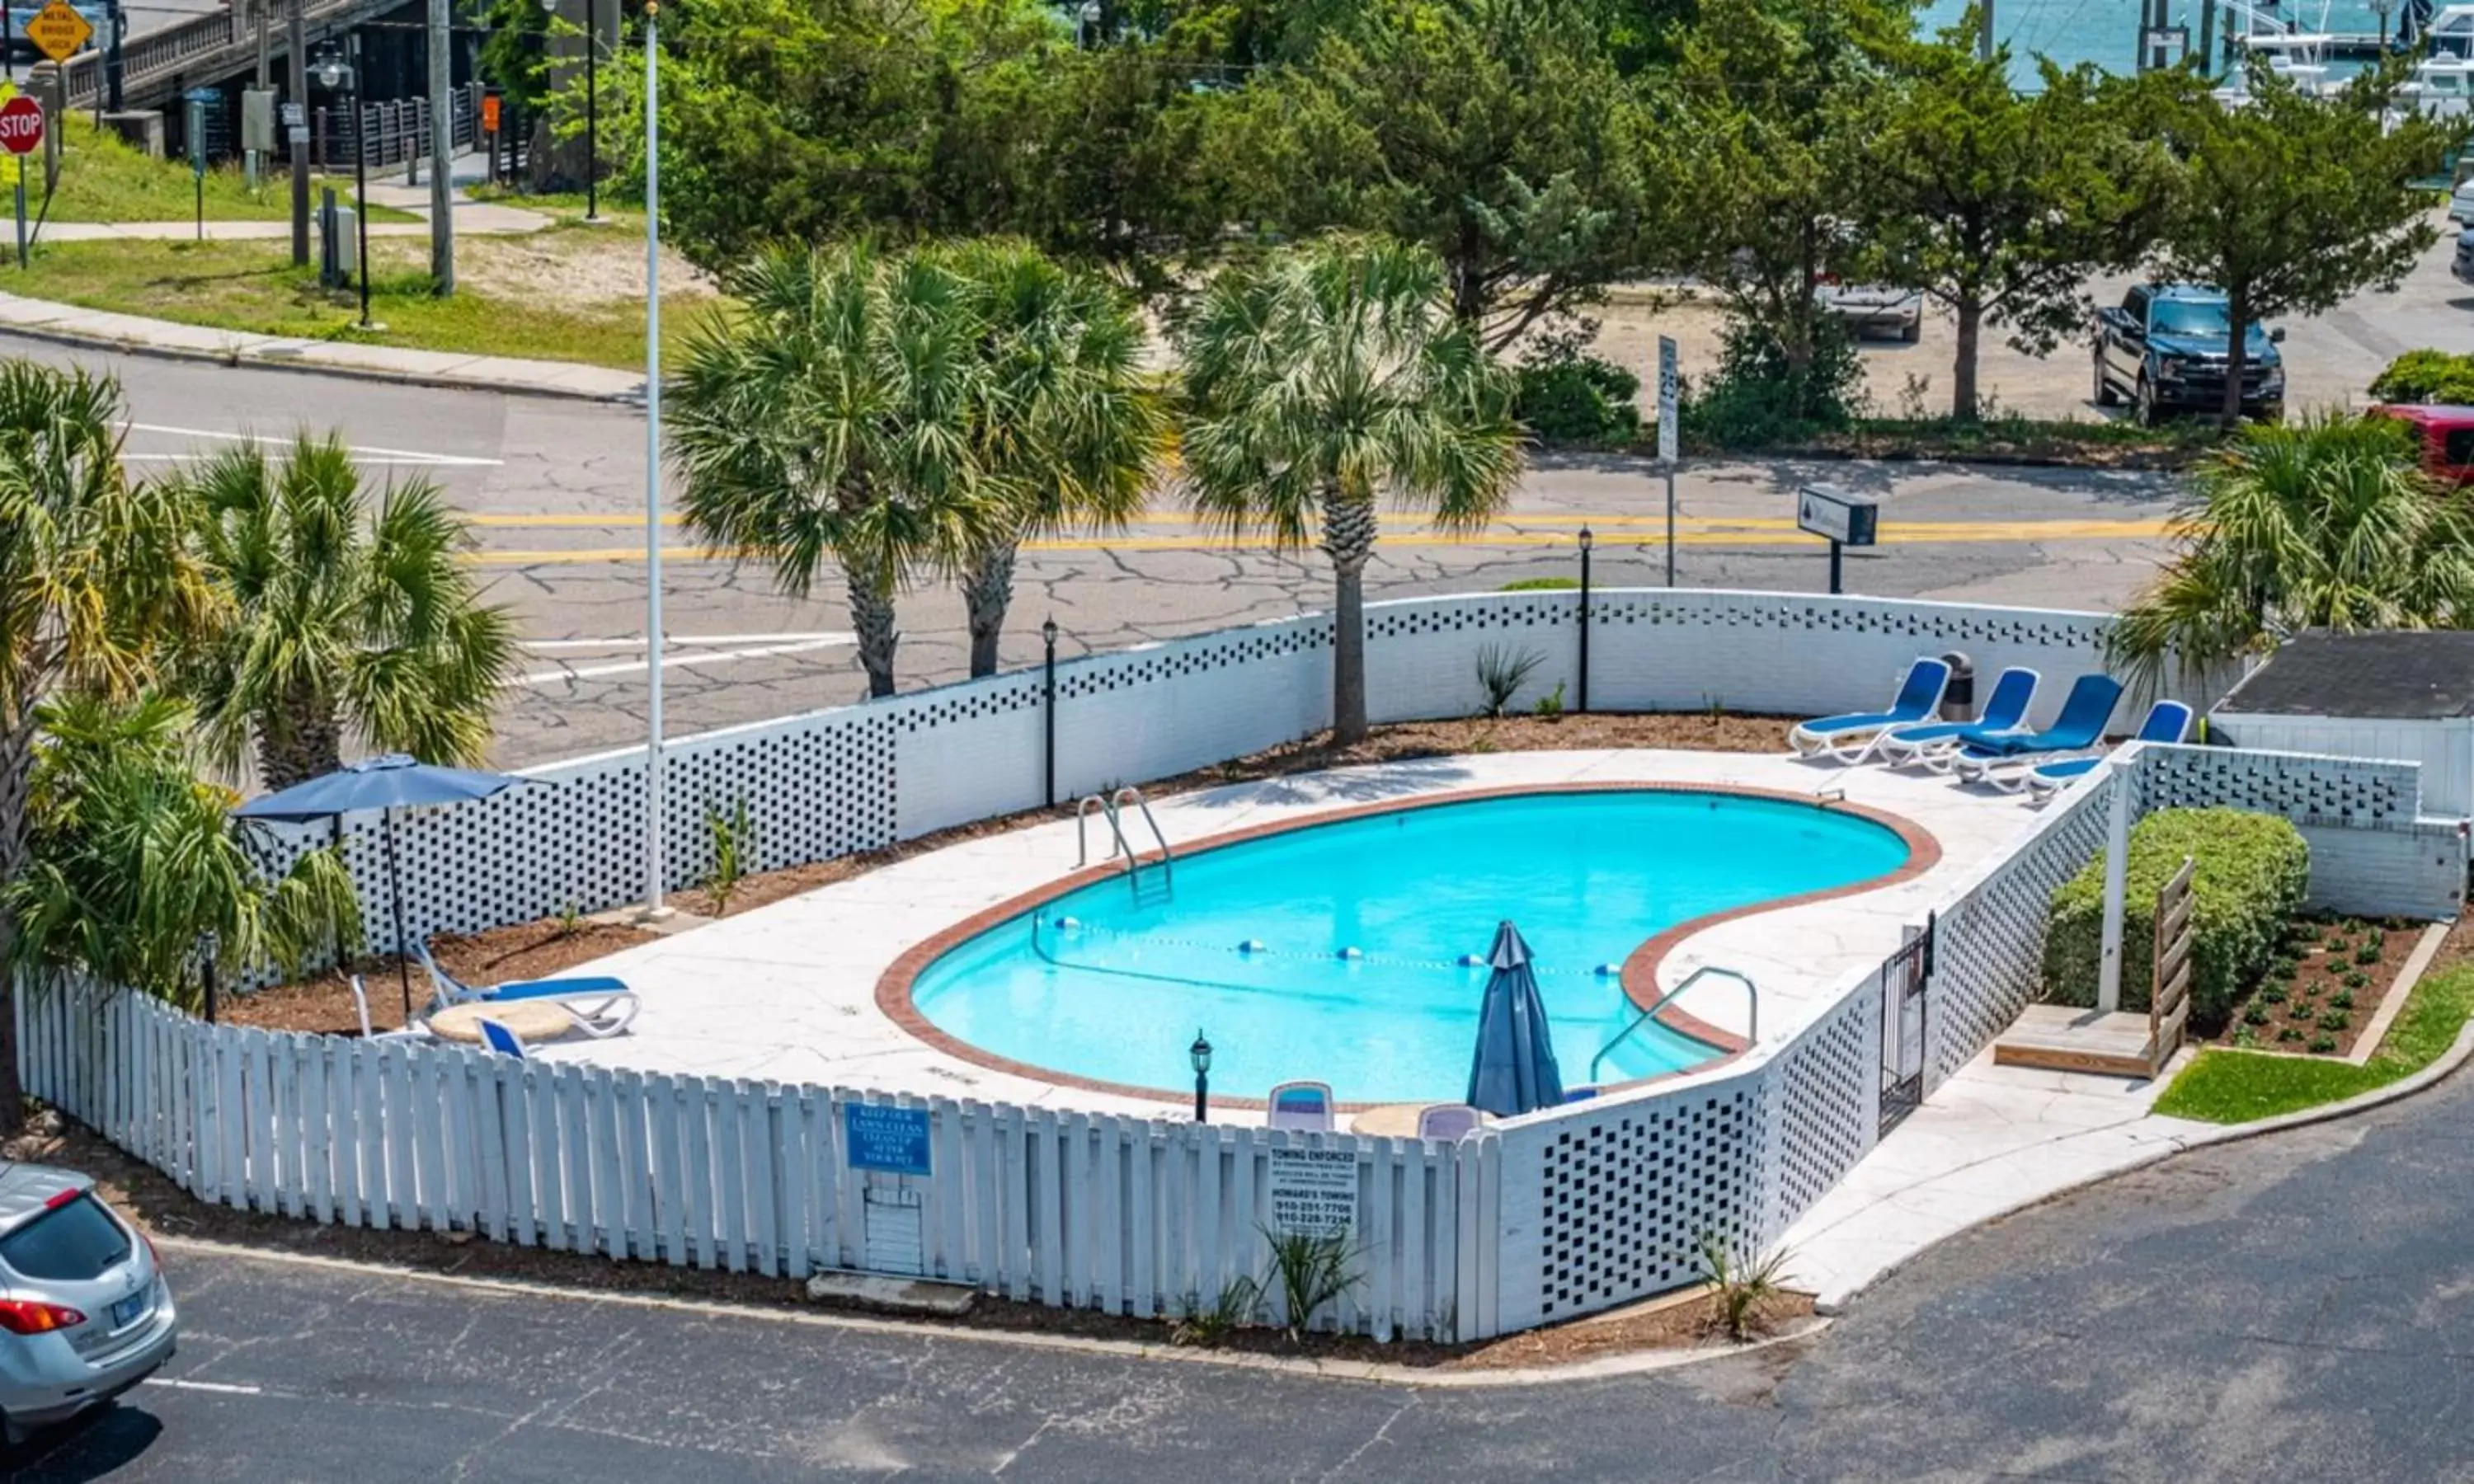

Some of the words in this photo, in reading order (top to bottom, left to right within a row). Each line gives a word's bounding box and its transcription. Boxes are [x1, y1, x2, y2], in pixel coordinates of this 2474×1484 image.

[41, 26, 75, 35] BRIDGE
[0, 113, 40, 138] STOP
[860, 1107, 887, 1119] KEEP
[852, 1116, 884, 1130] LAWN
[887, 1121, 923, 1134] CLEAN
[1272, 1148, 1305, 1160] TOWING
[1309, 1150, 1355, 1162] ENFORCED
[1272, 1188, 1318, 1200] HOWARD'S
[1320, 1190, 1355, 1201] TOWING
